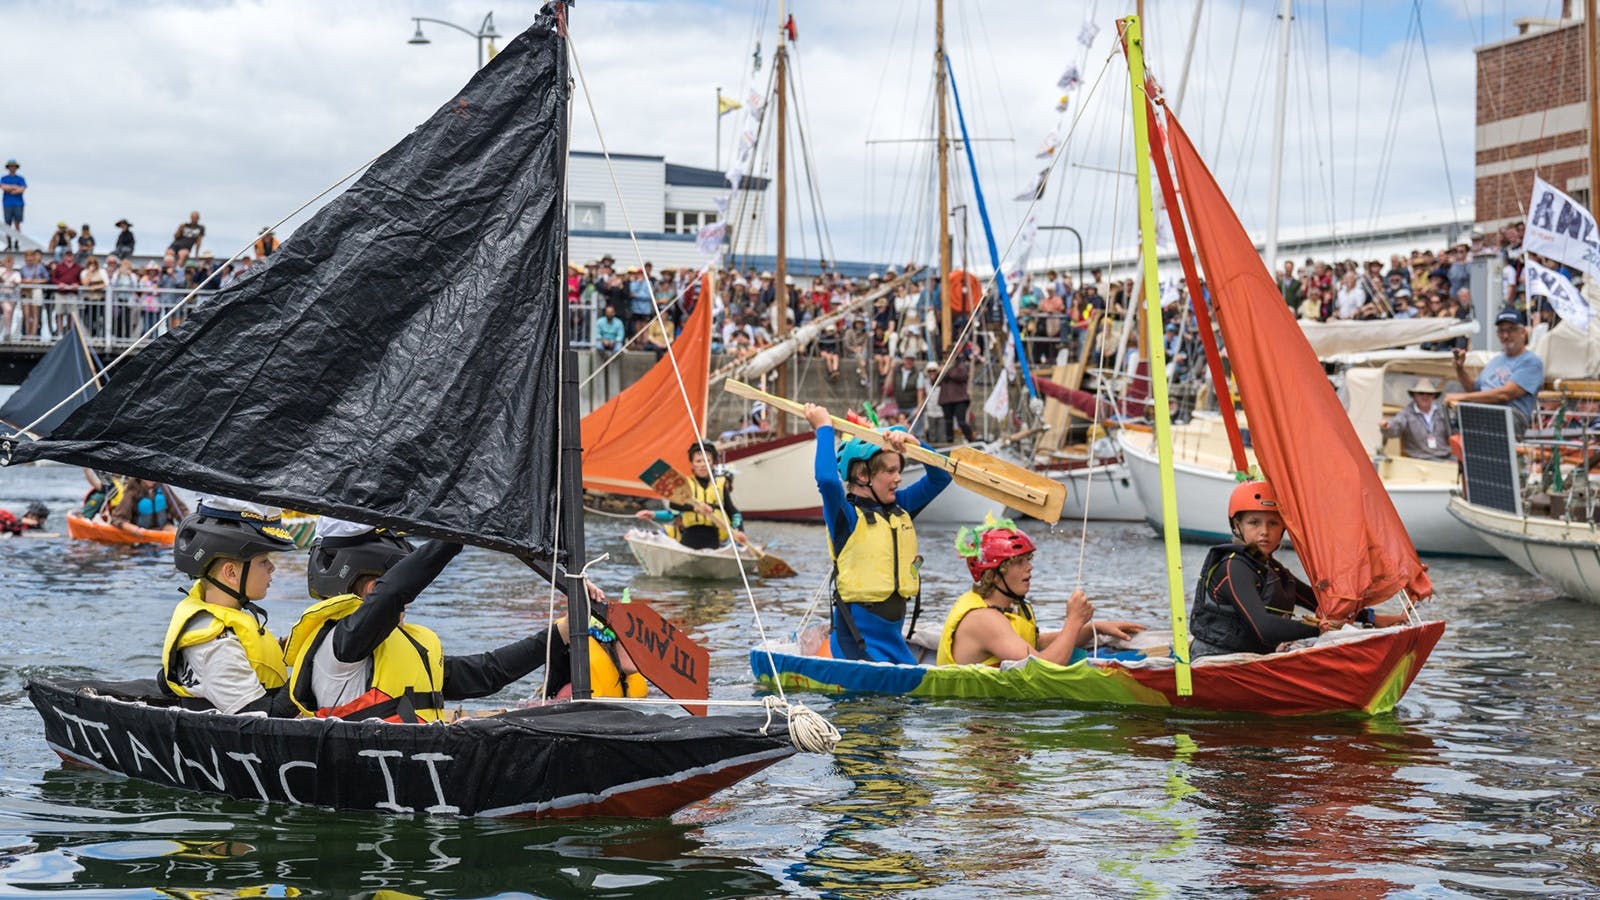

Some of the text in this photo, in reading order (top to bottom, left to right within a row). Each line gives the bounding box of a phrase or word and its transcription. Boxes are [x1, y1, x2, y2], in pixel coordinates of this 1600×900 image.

[625, 612, 697, 685] TITANIC
[660, 617, 676, 641] II
[52, 705, 460, 814] TITANIC II
